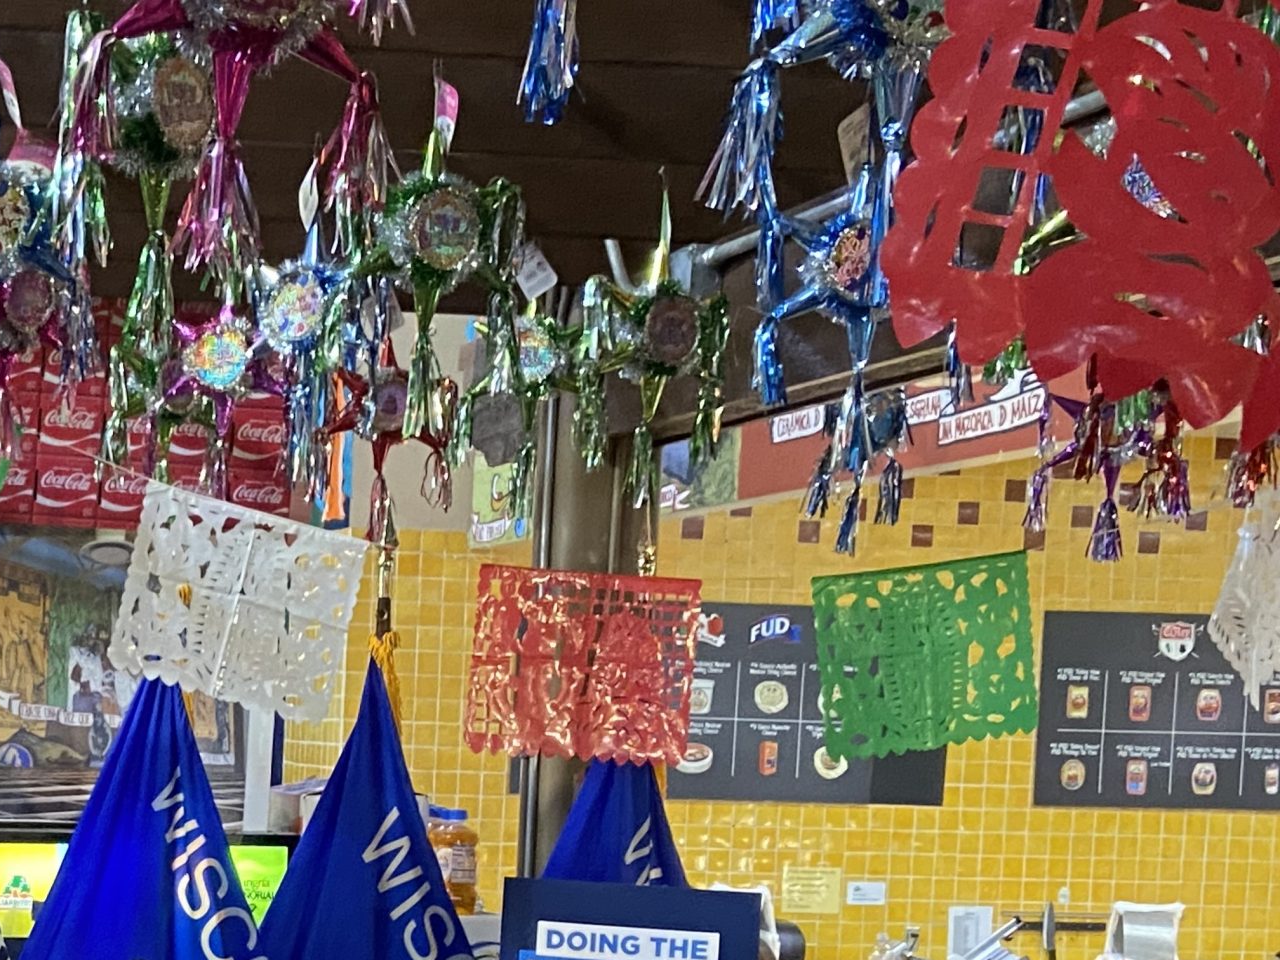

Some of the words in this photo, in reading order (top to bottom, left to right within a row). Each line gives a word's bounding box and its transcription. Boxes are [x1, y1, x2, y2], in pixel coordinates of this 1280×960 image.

[749, 616, 790, 644] FUD
[545, 929, 641, 956] DOING
[650, 936, 709, 960] THE
